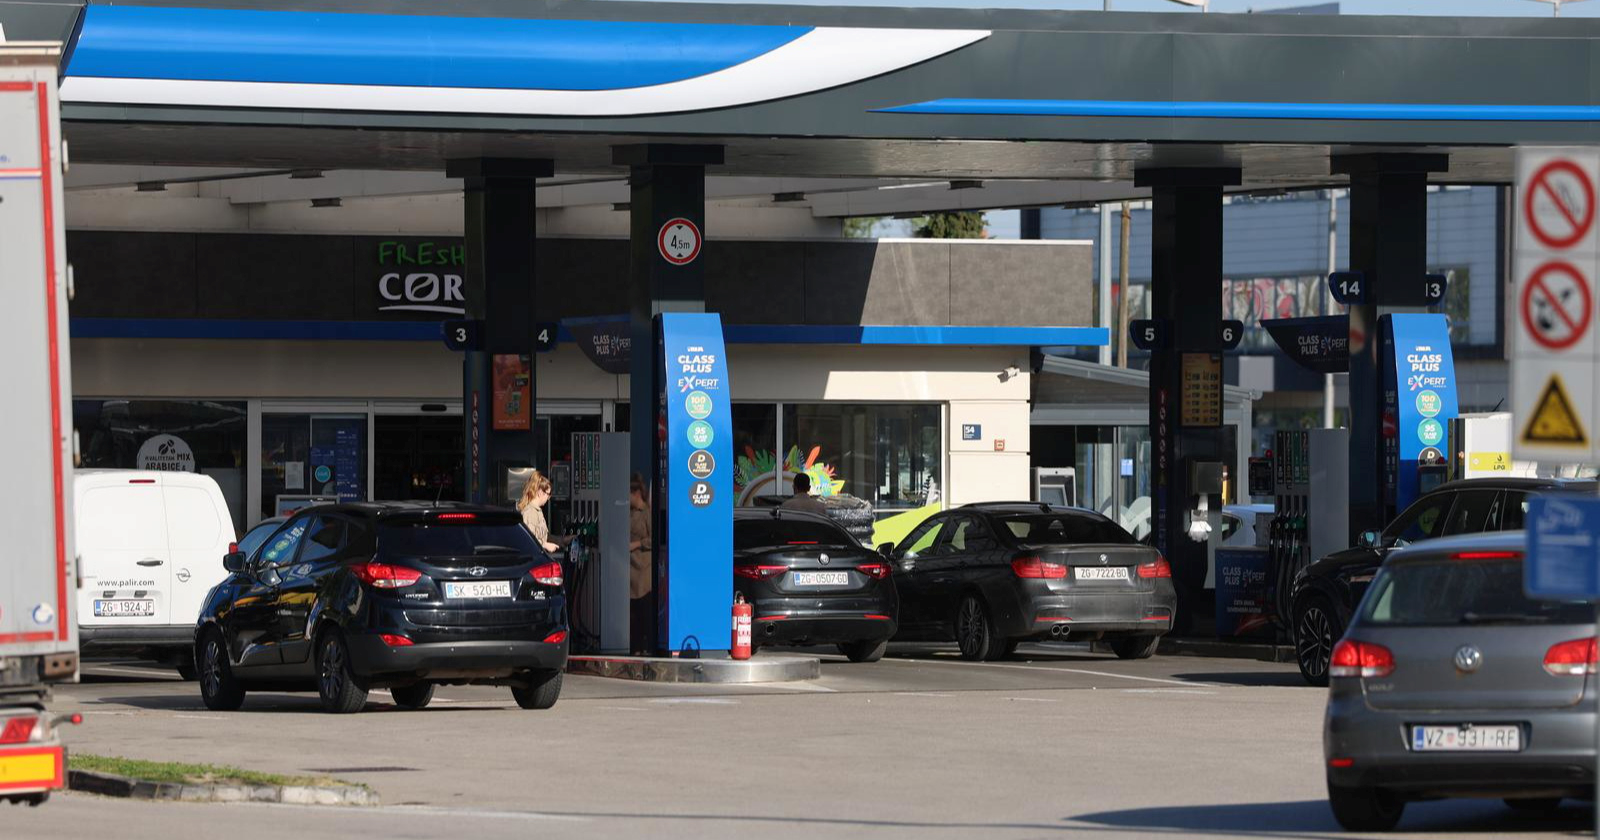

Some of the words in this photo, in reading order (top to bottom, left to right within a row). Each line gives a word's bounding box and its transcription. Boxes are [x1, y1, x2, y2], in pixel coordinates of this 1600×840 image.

[671, 234, 690, 250] 4,5m
[378, 241, 465, 267] FRESH
[1339, 280, 1360, 296] 14
[455, 327, 467, 342] 3
[538, 328, 549, 343] 4
[592, 334, 610, 345] CLASS
[1144, 327, 1155, 341] 5
[1222, 327, 1233, 342] 6
[1297, 335, 1320, 346] CLASS
[596, 344, 610, 355] PLUS
[1301, 345, 1319, 355] PLUS
[677, 354, 716, 365] CLASS
[1407, 354, 1442, 363] CLASS
[682, 364, 712, 373] PLUS
[1411, 363, 1440, 372] PLUS
[677, 375, 719, 392] EXPERT
[1407, 373, 1447, 391] EXPERT
[694, 426, 707, 435] 95
[965, 425, 975, 433] 54
[1424, 424, 1436, 432] 95
[176, 452, 191, 461] MIX
[697, 454, 706, 463] D
[1427, 450, 1436, 459] D
[145, 462, 180, 471] ARABICE
[696, 483, 707, 494] D
[801, 573, 811, 583] ZG
[1080, 568, 1091, 578] ZG
[96, 578, 155, 588] www.palir.com
[453, 585, 466, 597] SK
[102, 601, 113, 612] ZG
[1425, 729, 1444, 747] VZ
